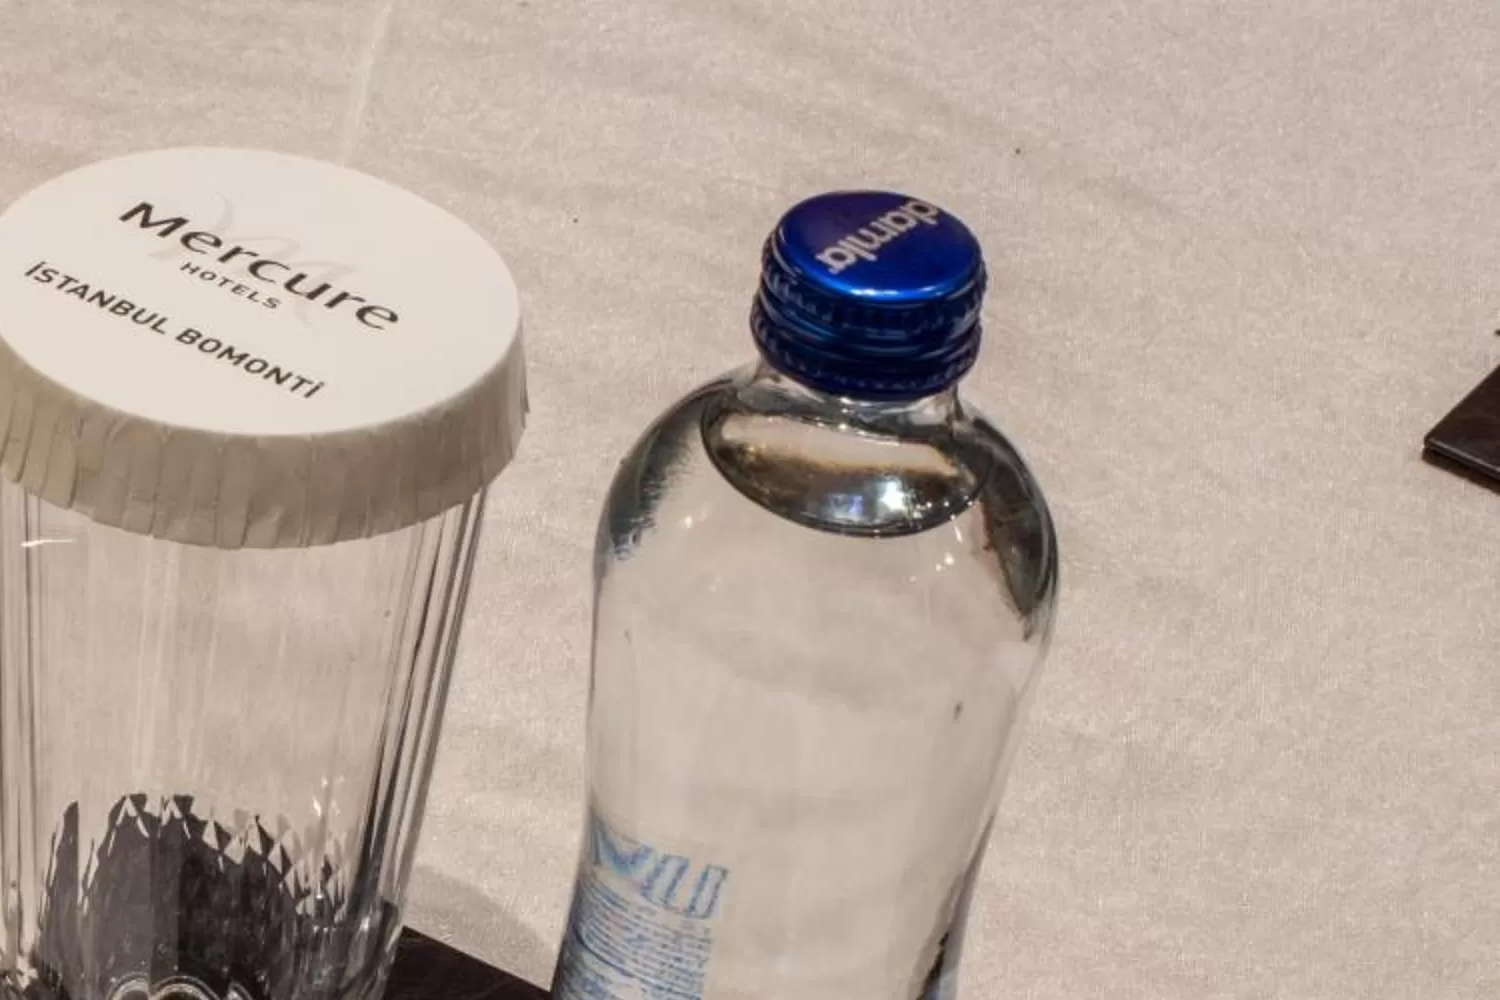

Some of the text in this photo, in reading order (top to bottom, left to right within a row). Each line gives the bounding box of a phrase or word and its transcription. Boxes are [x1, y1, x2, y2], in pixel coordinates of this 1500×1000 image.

[118, 201, 400, 331] Mercure
[179, 261, 282, 310] HOTELS
[814, 198, 940, 275] damla
[24, 260, 326, 400] İSTANBUL BOMONTİ
